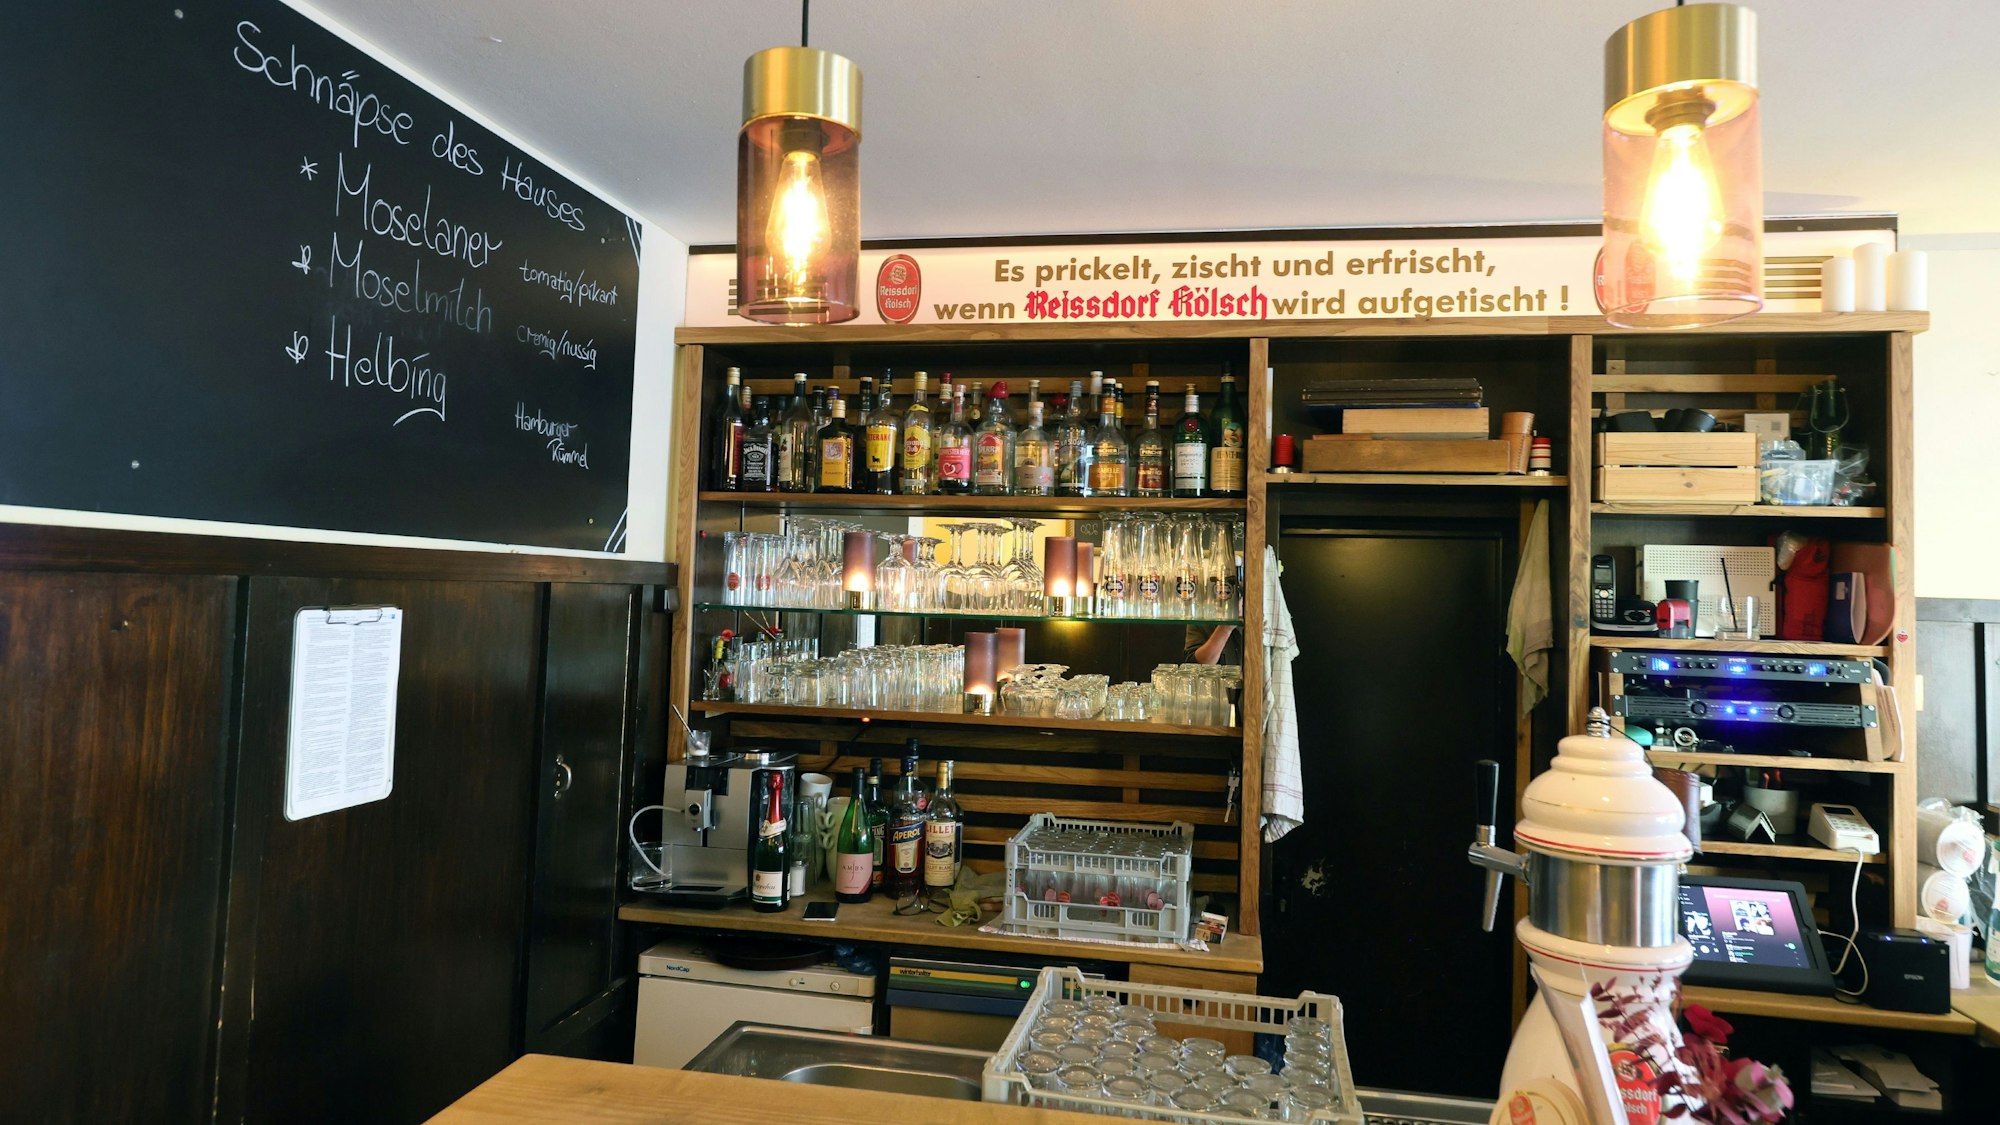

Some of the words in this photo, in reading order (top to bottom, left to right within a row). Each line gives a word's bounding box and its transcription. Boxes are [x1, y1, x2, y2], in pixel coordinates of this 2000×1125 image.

[234, 20, 413, 147] Schnäpse
[432, 121, 484, 175] des
[501, 156, 586, 231] Hauses
[336, 152, 503, 268] Moselaner
[329, 232, 492, 333] Moselmilch
[519, 259, 619, 306] tomatig/pikant
[994, 259, 1025, 282] Es
[1035, 255, 1162, 287] prickelt,
[1172, 254, 1262, 280] zischt
[1274, 250, 1334, 277] und
[1346, 246, 1497, 277] erfrischt,
[880, 284, 918, 296] Reissdorf
[884, 297, 912, 310] Kölsch
[933, 299, 1016, 320] wenn
[1024, 285, 1163, 320] Reissdorf
[1168, 283, 1269, 321] Kölsch
[1272, 285, 1351, 316] wird
[1357, 283, 1548, 319] aufgetischt
[1560, 284, 1570, 311] !
[325, 315, 447, 427] Helbing
[514, 402, 579, 448] Hamburger
[892, 827, 920, 842] APEROL
[1621, 1086, 1658, 1102] ssdorf
